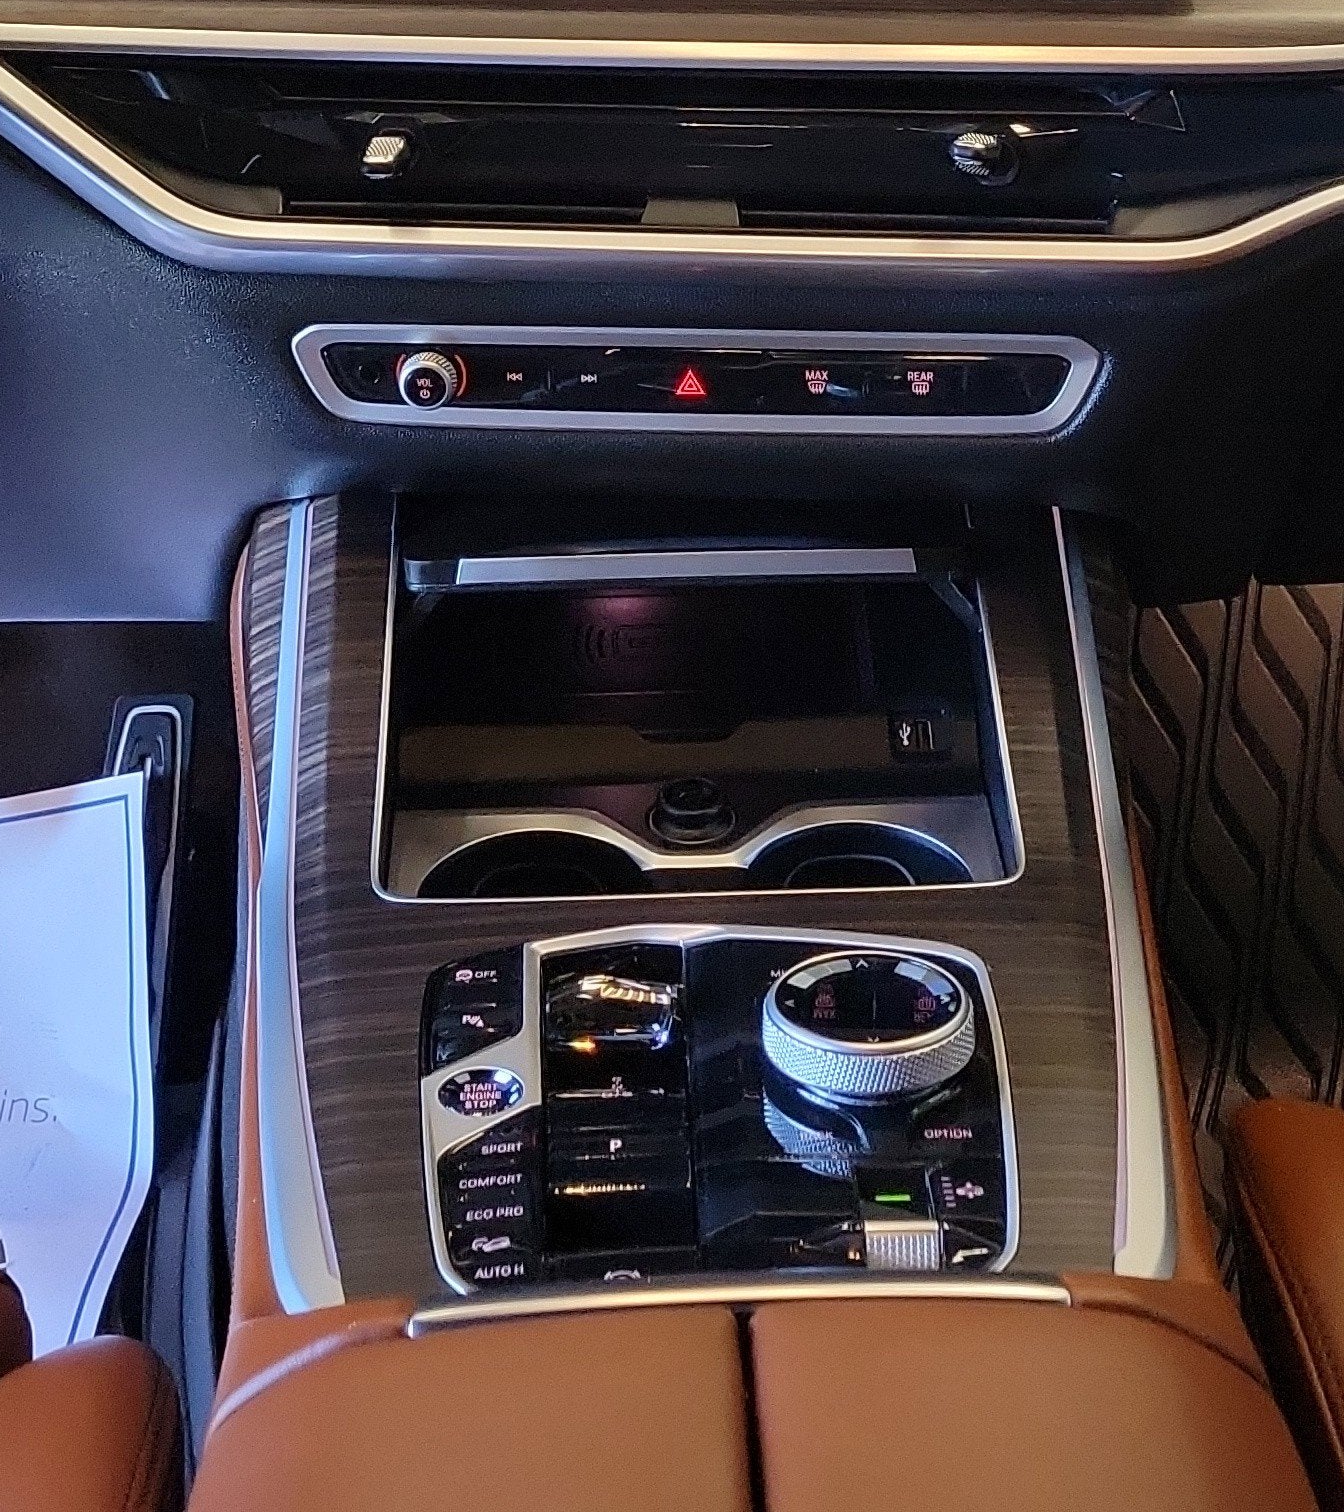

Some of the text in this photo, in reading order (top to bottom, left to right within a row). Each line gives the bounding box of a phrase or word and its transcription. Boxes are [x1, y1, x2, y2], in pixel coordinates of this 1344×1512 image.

[806, 370, 828, 381] MAX
[908, 371, 934, 383] REAR
[416, 378, 433, 388] VOL
[474, 970, 497, 979] OFF
[463, 1083, 498, 1092] START
[460, 1091, 502, 1101] ENGINE
[464, 1100, 497, 1109] STOP
[924, 1128, 973, 1139] OPTION
[481, 1142, 524, 1155] SPORT
[610, 1139, 623, 1153] P
[459, 1173, 523, 1189] COMFORT
[466, 1205, 524, 1222] ECO PRO
[474, 1262, 524, 1279] AUTO H
